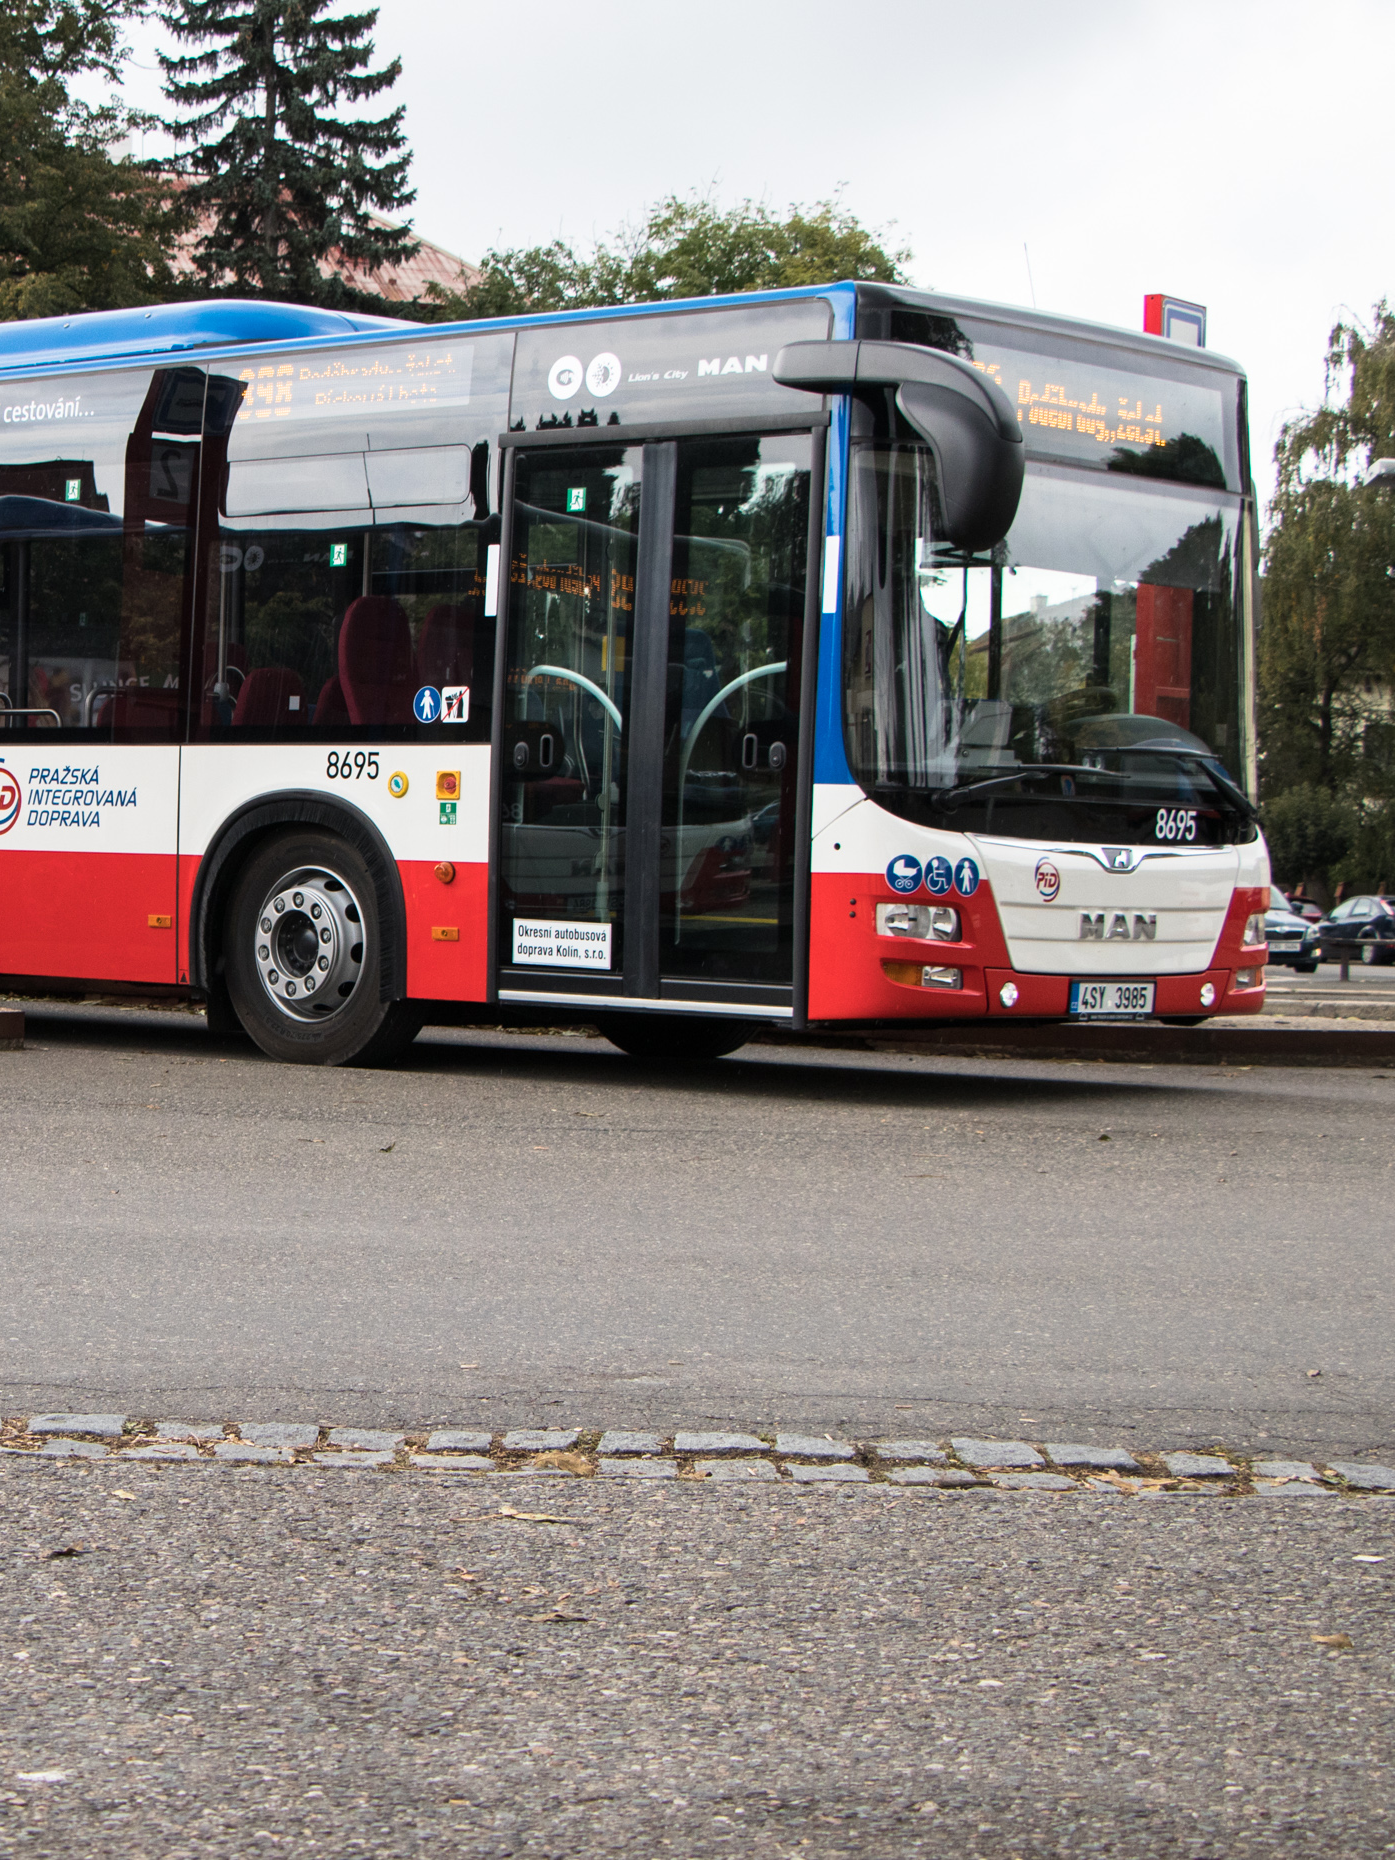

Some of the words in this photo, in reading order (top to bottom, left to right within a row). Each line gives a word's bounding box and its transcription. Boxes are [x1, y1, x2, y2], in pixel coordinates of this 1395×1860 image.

[628, 371, 660, 382] Lion's
[663, 369, 689, 381] City
[697, 354, 768, 377] MAN
[28, 765, 100, 785] PRAŽSKÁ
[326, 750, 380, 780] 8695
[27, 786, 138, 807] INTEGROVANÁ
[26, 810, 100, 827] DOPRAVA
[1155, 808, 1198, 842] 8695
[517, 925, 552, 938] Okresní
[554, 928, 607, 942] autobusová
[1078, 910, 1157, 940] MAN
[517, 943, 553, 957] doprava
[556, 945, 582, 960] Kolín,
[584, 948, 607, 960] s.r.o.
[1081, 986, 1106, 1009] 4SY
[1114, 986, 1148, 1009] 3985
